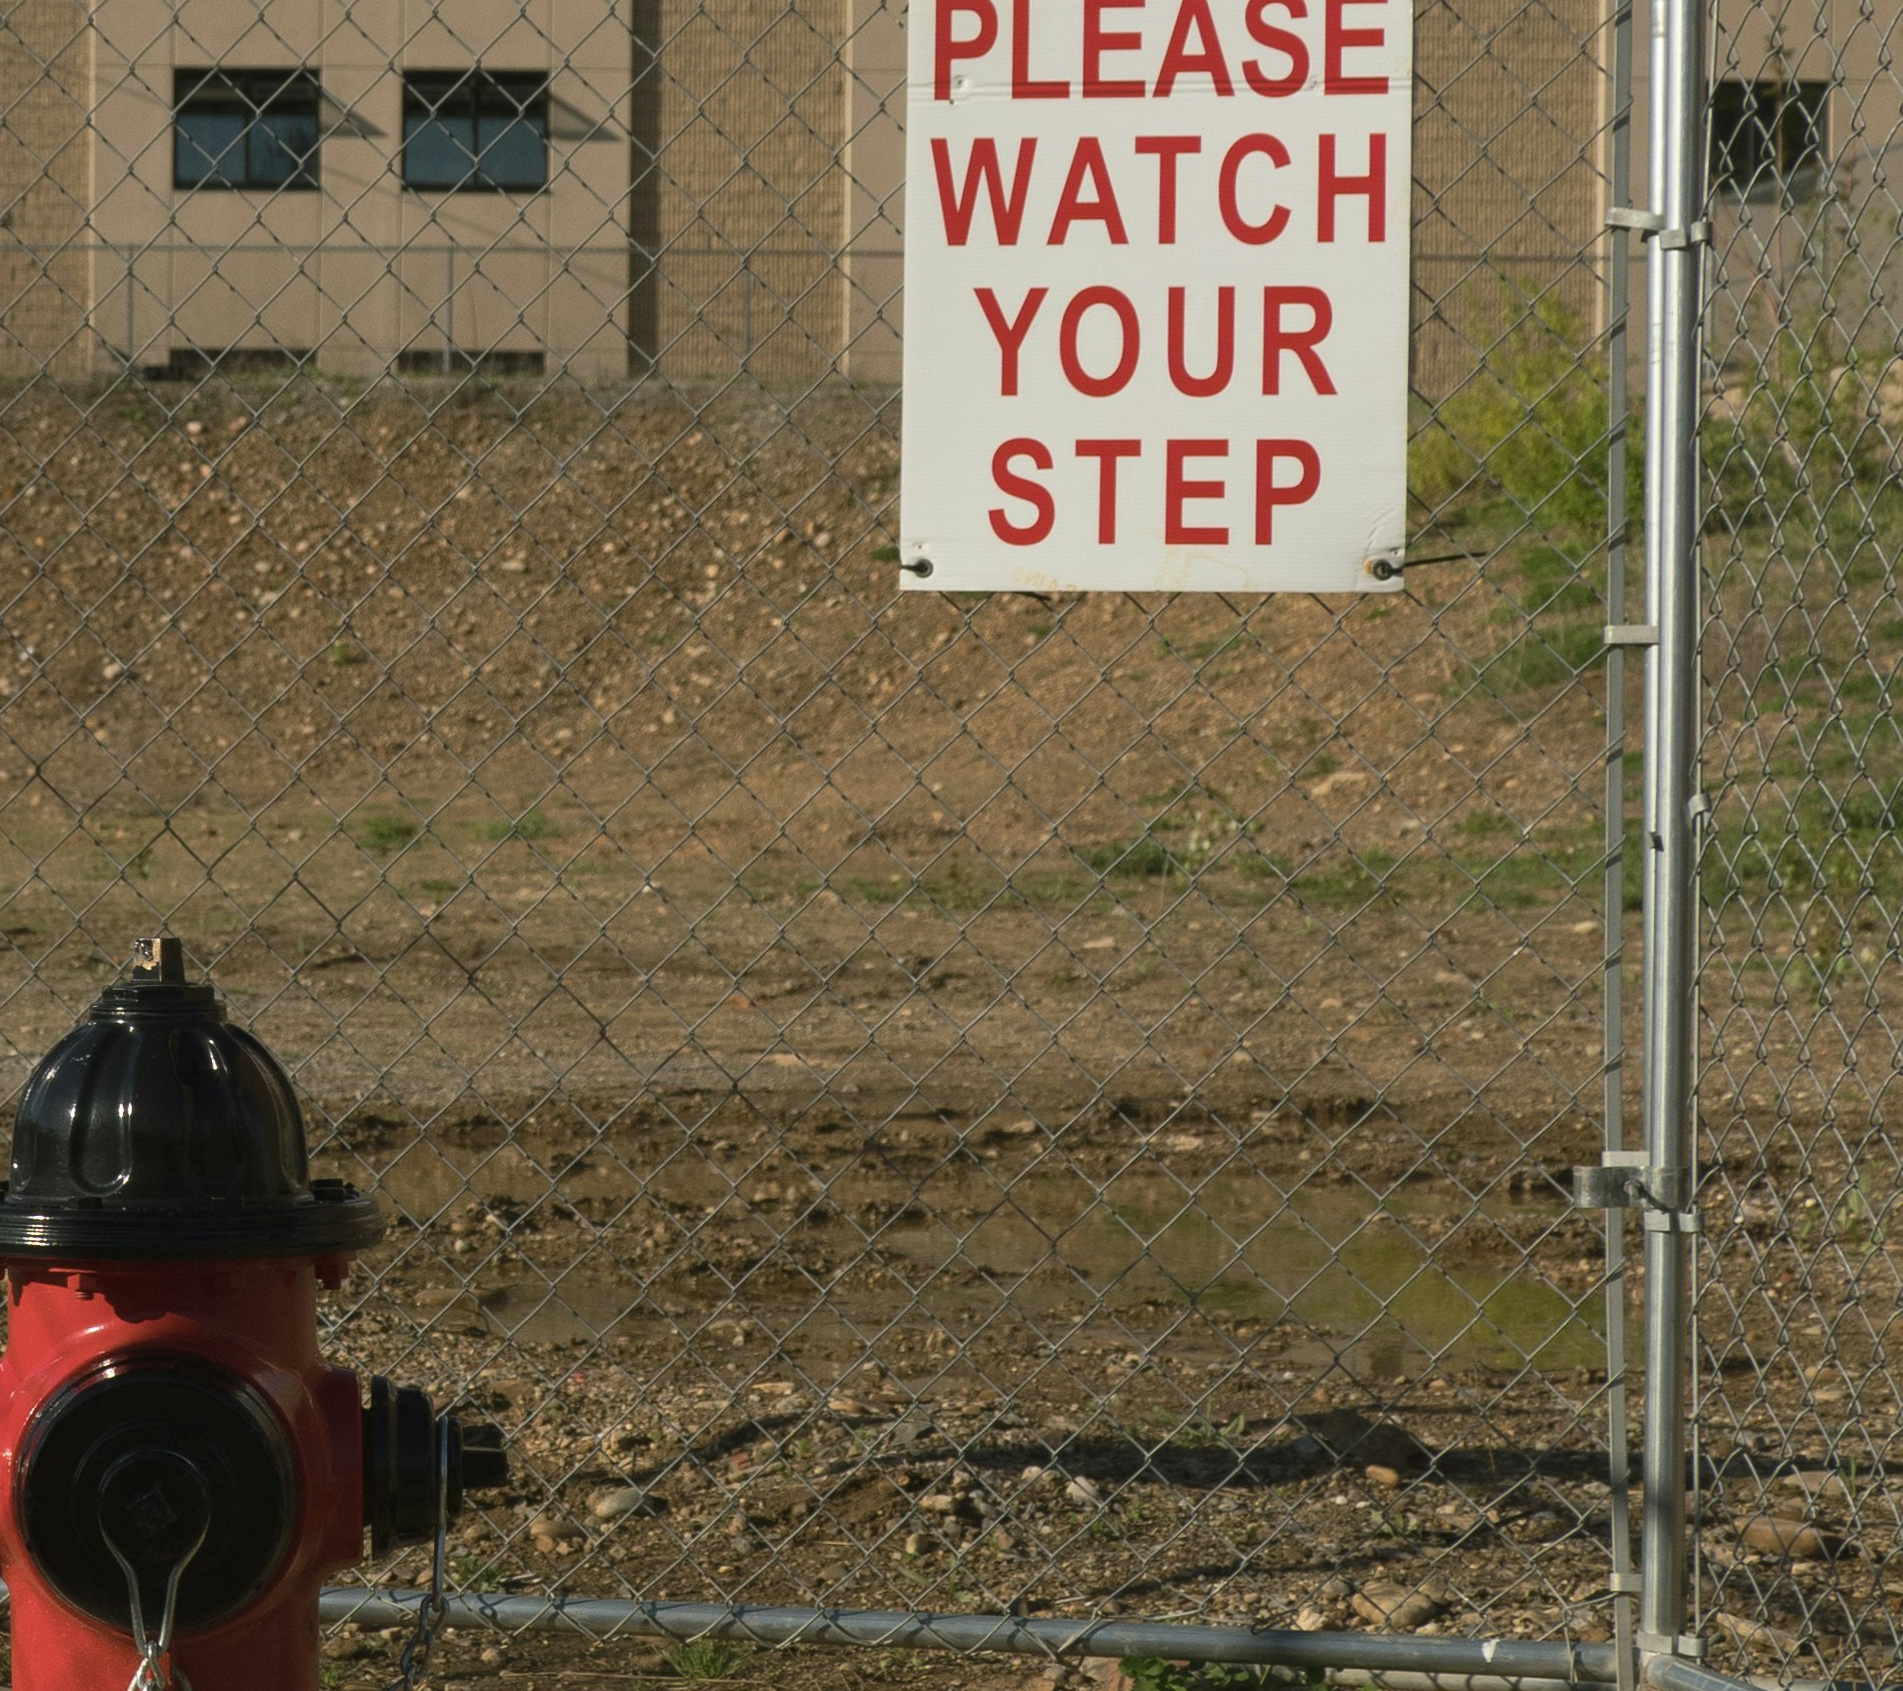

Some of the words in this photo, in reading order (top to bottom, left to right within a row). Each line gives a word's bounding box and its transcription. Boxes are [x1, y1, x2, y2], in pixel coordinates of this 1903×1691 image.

[930, 133, 1387, 246] WATCH
[974, 285, 1338, 398] YOUR
[988, 437, 1321, 546] STEP
